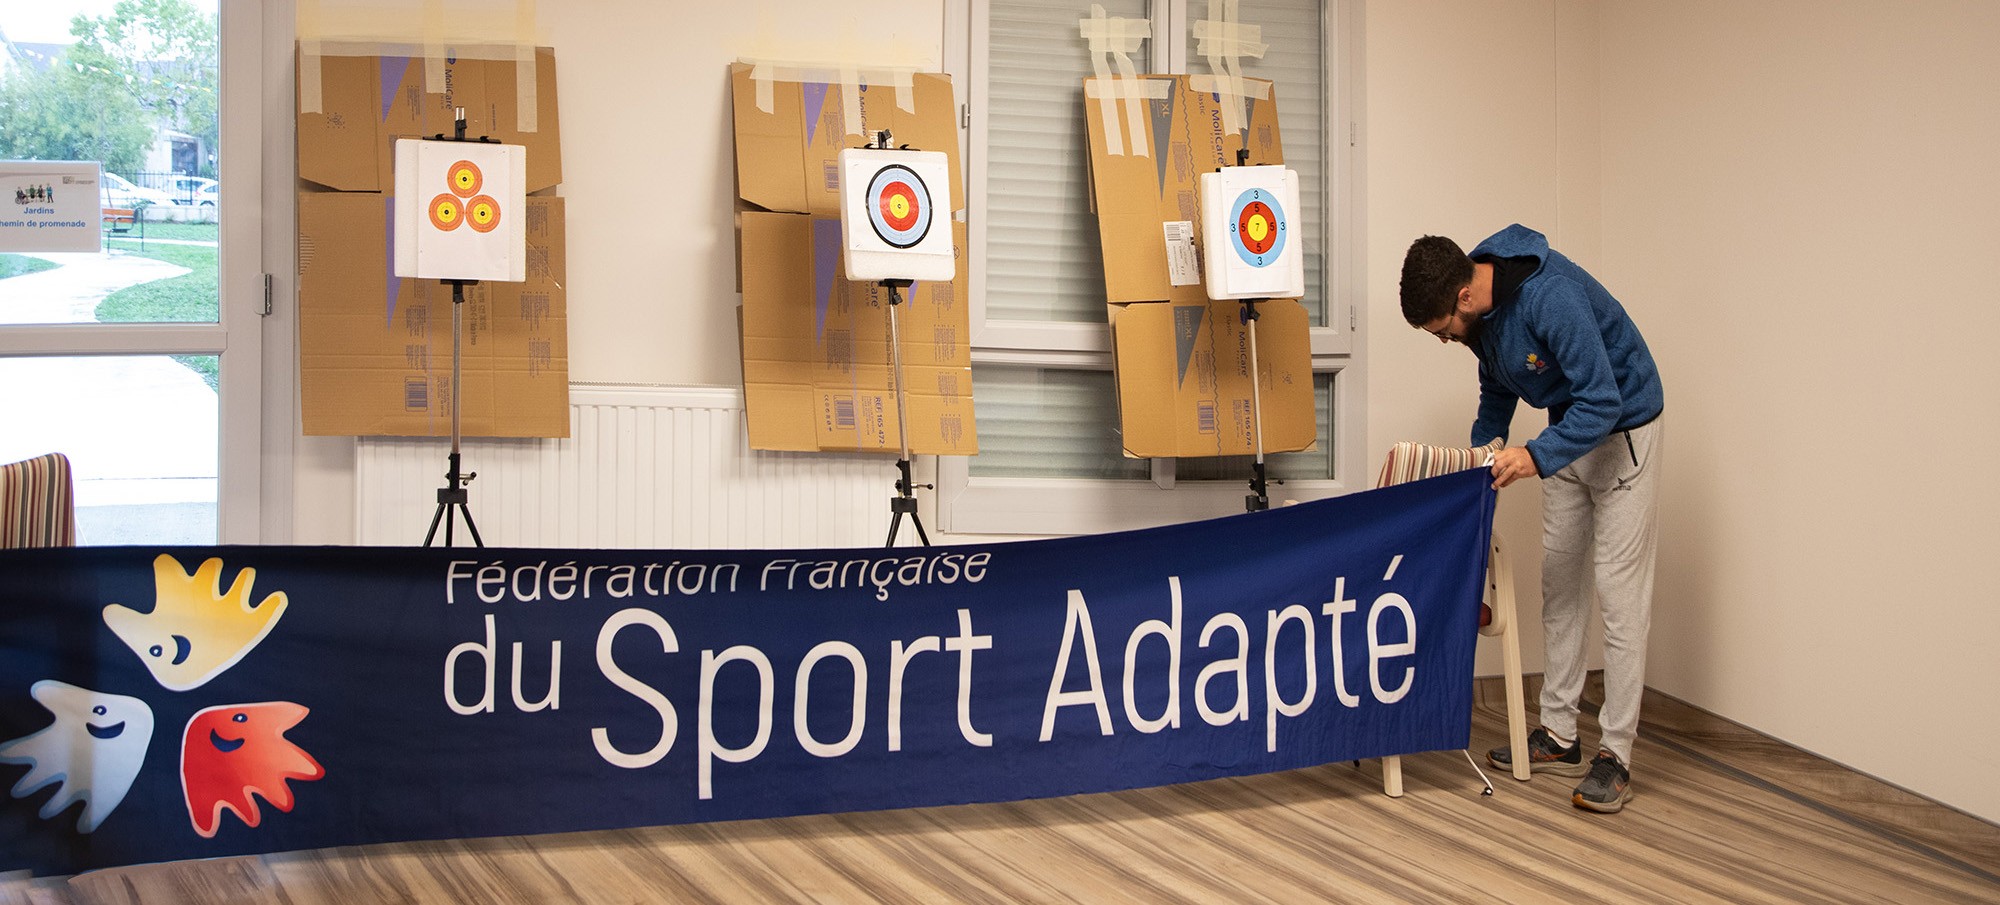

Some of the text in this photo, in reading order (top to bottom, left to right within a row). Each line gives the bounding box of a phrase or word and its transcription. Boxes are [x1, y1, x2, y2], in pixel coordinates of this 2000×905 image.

[445, 69, 453, 110] MoliCare
[1211, 109, 1224, 164] MoliCare
[1253, 189, 1260, 200] 3
[23, 207, 55, 215] Jardins
[1254, 203, 1260, 213] 5
[26, 220, 37, 228] de
[39, 220, 86, 229] promenade
[1230, 221, 1286, 233] 3 5 7 5 3
[1256, 242, 1262, 252] 5
[1257, 256, 1263, 266] 3
[1239, 331, 1247, 376] MoliCare
[874, 397, 882, 412] REF
[878, 430, 886, 444] 472
[445, 551, 992, 604] Fédération Française
[443, 554, 1417, 800] du Sport Adapté
